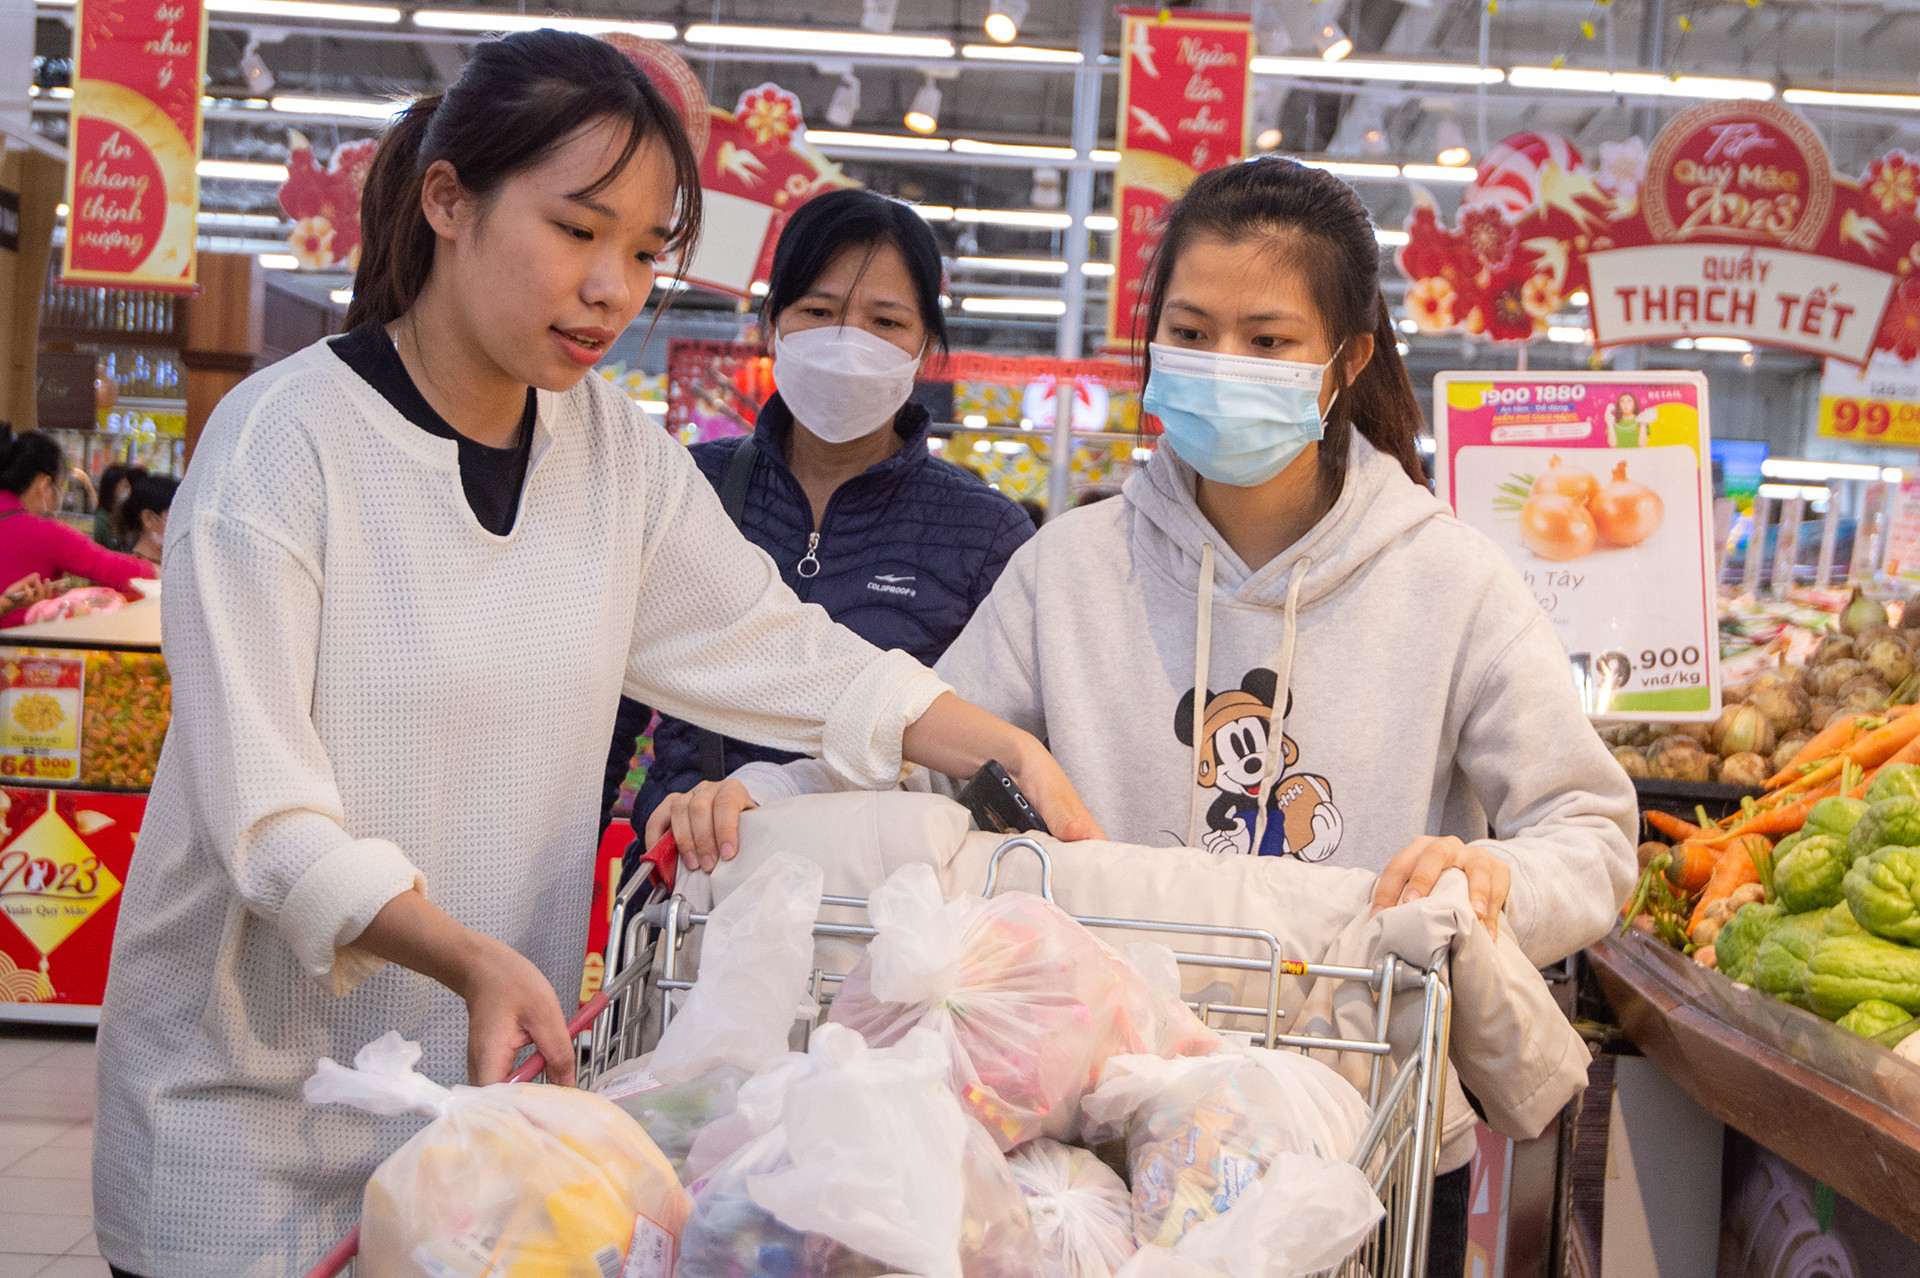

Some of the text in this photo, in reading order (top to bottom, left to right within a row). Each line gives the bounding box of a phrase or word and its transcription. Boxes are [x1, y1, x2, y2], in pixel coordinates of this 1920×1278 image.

[145, 28, 192, 55] như
[97, 131, 132, 159] An
[79, 160, 149, 197] khang
[82, 195, 143, 226] thịnh
[1677, 185, 1800, 241] 2023
[1614, 284, 1855, 340] THẠCH TẾT
[1480, 384, 1586, 406] 1900 1880
[1647, 389, 1683, 401] RETAIL
[1546, 570, 1585, 589] Tây
